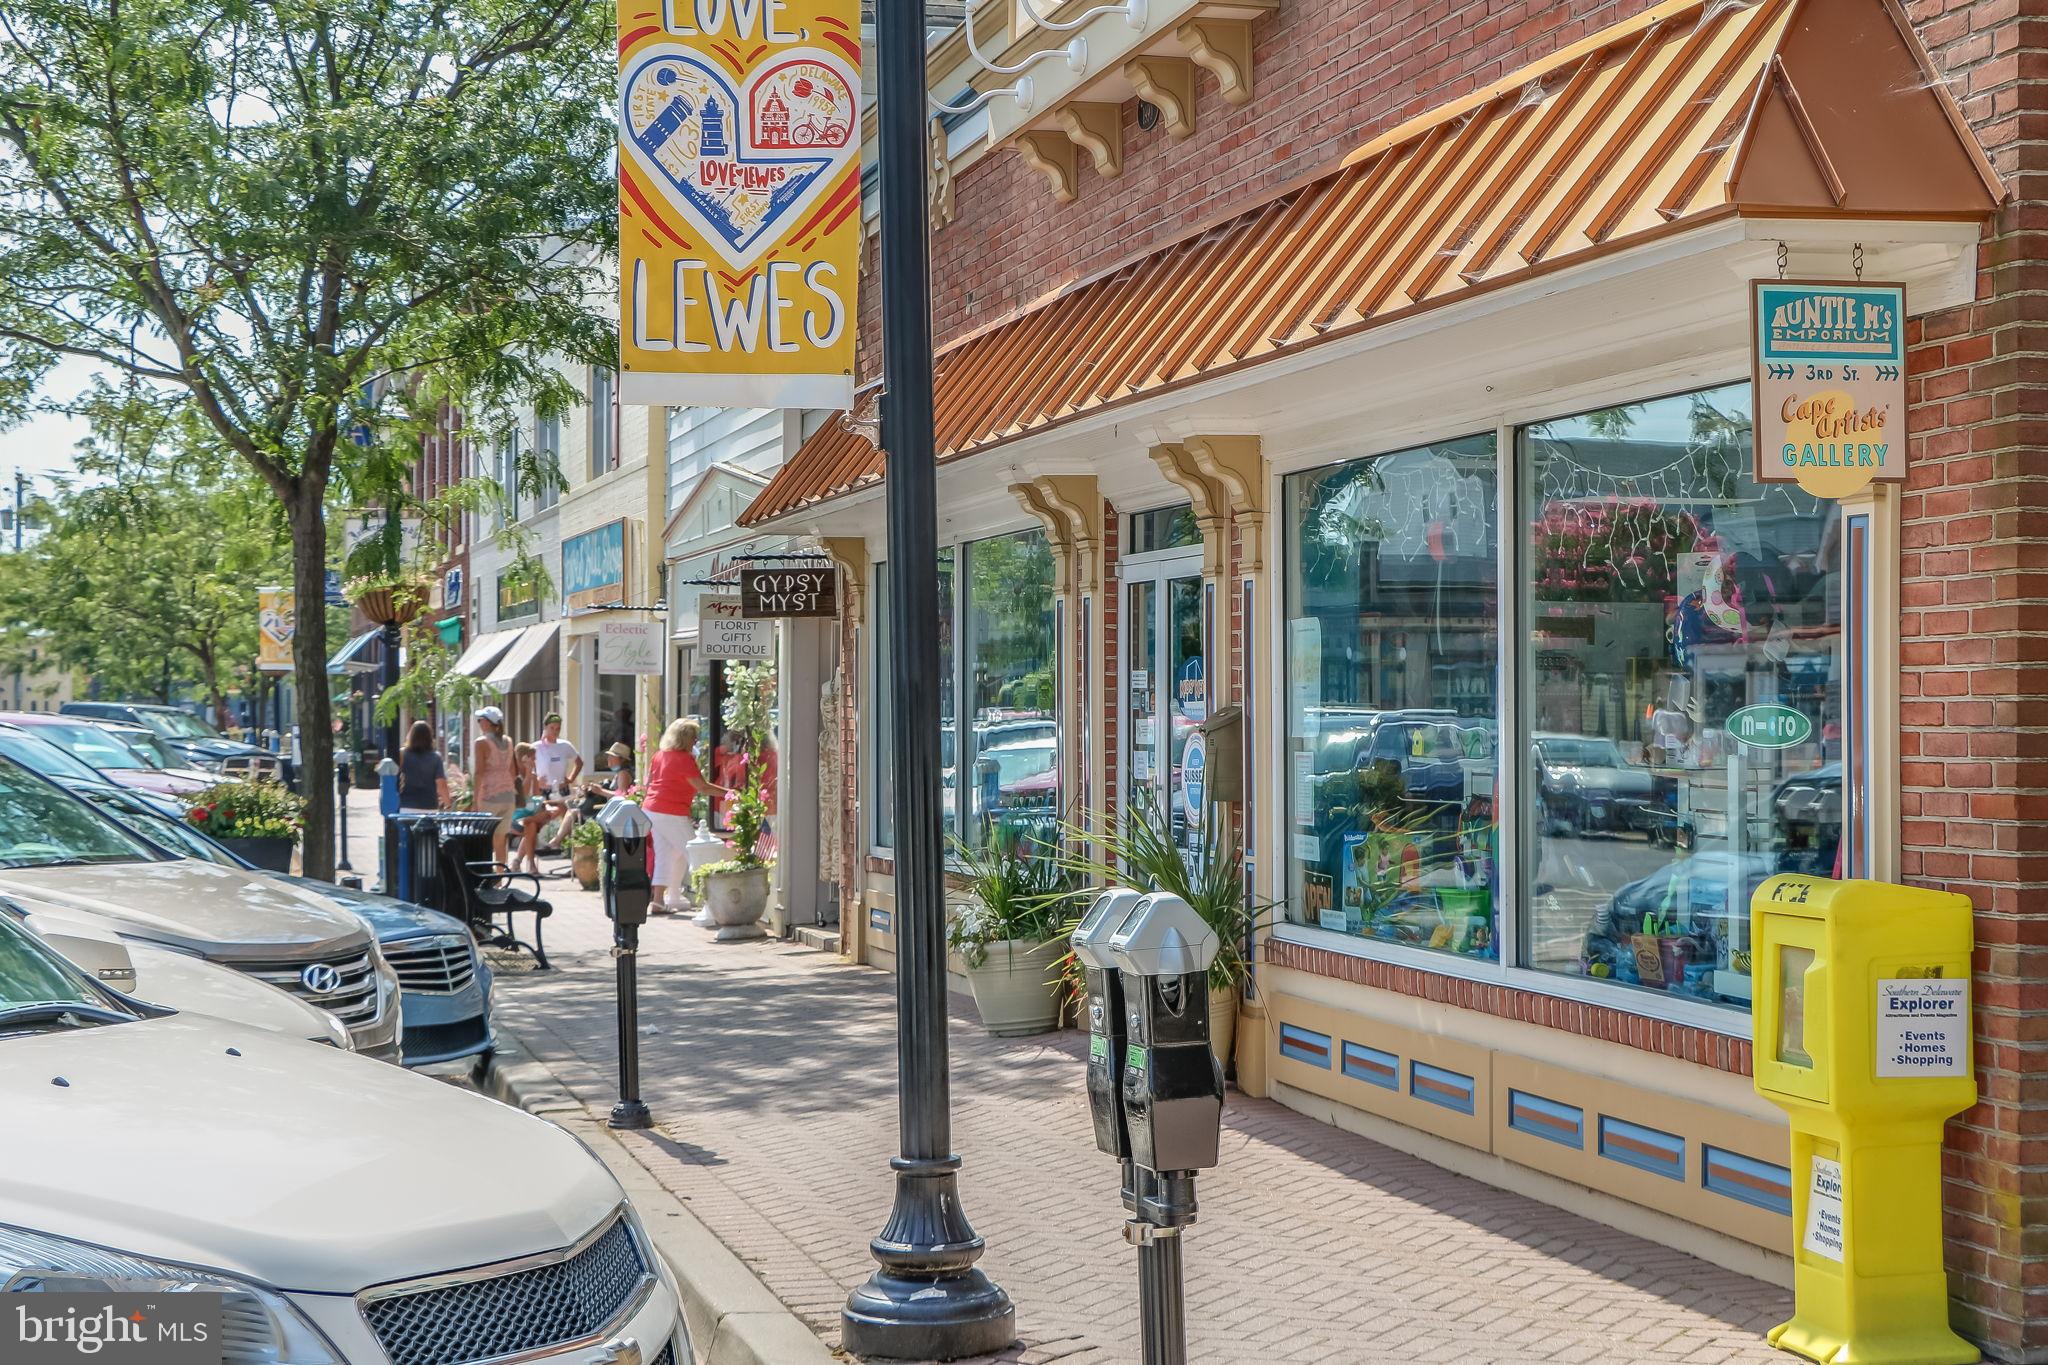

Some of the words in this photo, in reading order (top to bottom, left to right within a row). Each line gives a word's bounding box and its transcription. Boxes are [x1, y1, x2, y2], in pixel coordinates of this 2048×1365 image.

[800, 66, 848, 101] DELAWARE
[634, 84, 645, 129] FIRST
[646, 88, 657, 121] STATE
[807, 95, 836, 116] 19958
[700, 160, 737, 186] LOVE
[742, 166, 786, 189] LEWES
[740, 199, 761, 223] FIRST
[752, 200, 770, 219] TOWN
[633, 258, 845, 354] LEWES
[1771, 296, 1857, 330] AUNTIE
[1773, 329, 1890, 342] EMPORIUM
[1806, 365, 1833, 381] 3RD
[1780, 393, 1836, 425] Cape
[1782, 444, 1888, 467] GALLERY
[753, 574, 825, 593] GYPSY
[760, 593, 819, 612] MYST
[605, 624, 649, 635] Eclectic
[714, 621, 759, 631] FLORIST
[721, 633, 752, 642] GIFTS
[706, 644, 767, 655] BOUTIQUE
[1185, 769, 1202, 783] SUSSE
[1882, 985, 1919, 997] Southern
[1921, 985, 1962, 996] Delaware
[1889, 997, 1955, 1012] Explorer
[1905, 1031, 1946, 1041] Events
[1905, 1043, 1946, 1053] Homes
[1896, 1055, 1953, 1067] Shopping
[1821, 1209, 1841, 1225] Events
[1819, 1221, 1840, 1237] Homes
[1814, 1231, 1843, 1252] Shopping
